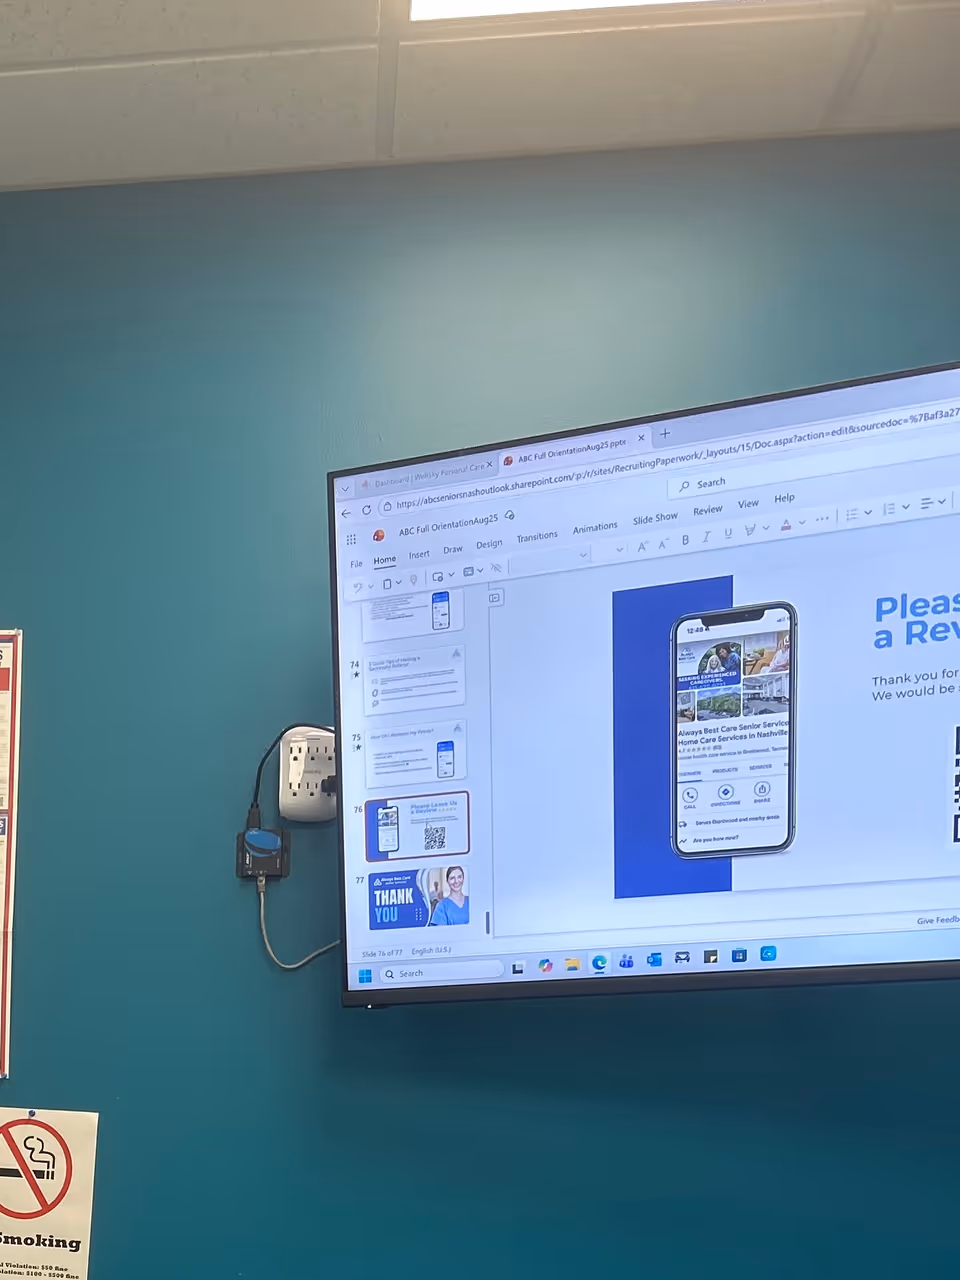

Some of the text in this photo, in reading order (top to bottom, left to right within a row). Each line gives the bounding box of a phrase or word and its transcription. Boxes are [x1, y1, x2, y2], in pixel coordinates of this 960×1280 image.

[518, 454, 533, 463] ABC
[534, 452, 547, 461] Full
[697, 477, 726, 489] Search
[350, 493, 795, 569] File Home Insert Draw Design Transitions Animations Slide Show Review View Help
[399, 513, 499, 537] ABC Full OrientationAug25
[873, 629, 893, 650] a
[350, 660, 360, 669] 74
[871, 668, 959, 687] Thank you for
[871, 684, 955, 701] We would be
[678, 734, 748, 746] Home Care Services
[356, 876, 364, 884] 77
[374, 887, 414, 906] THANK
[375, 906, 398, 923] YOU
[411, 948, 434, 956] English
[399, 969, 423, 978] Search
[5, 1262, 40, 1270] Violation:
